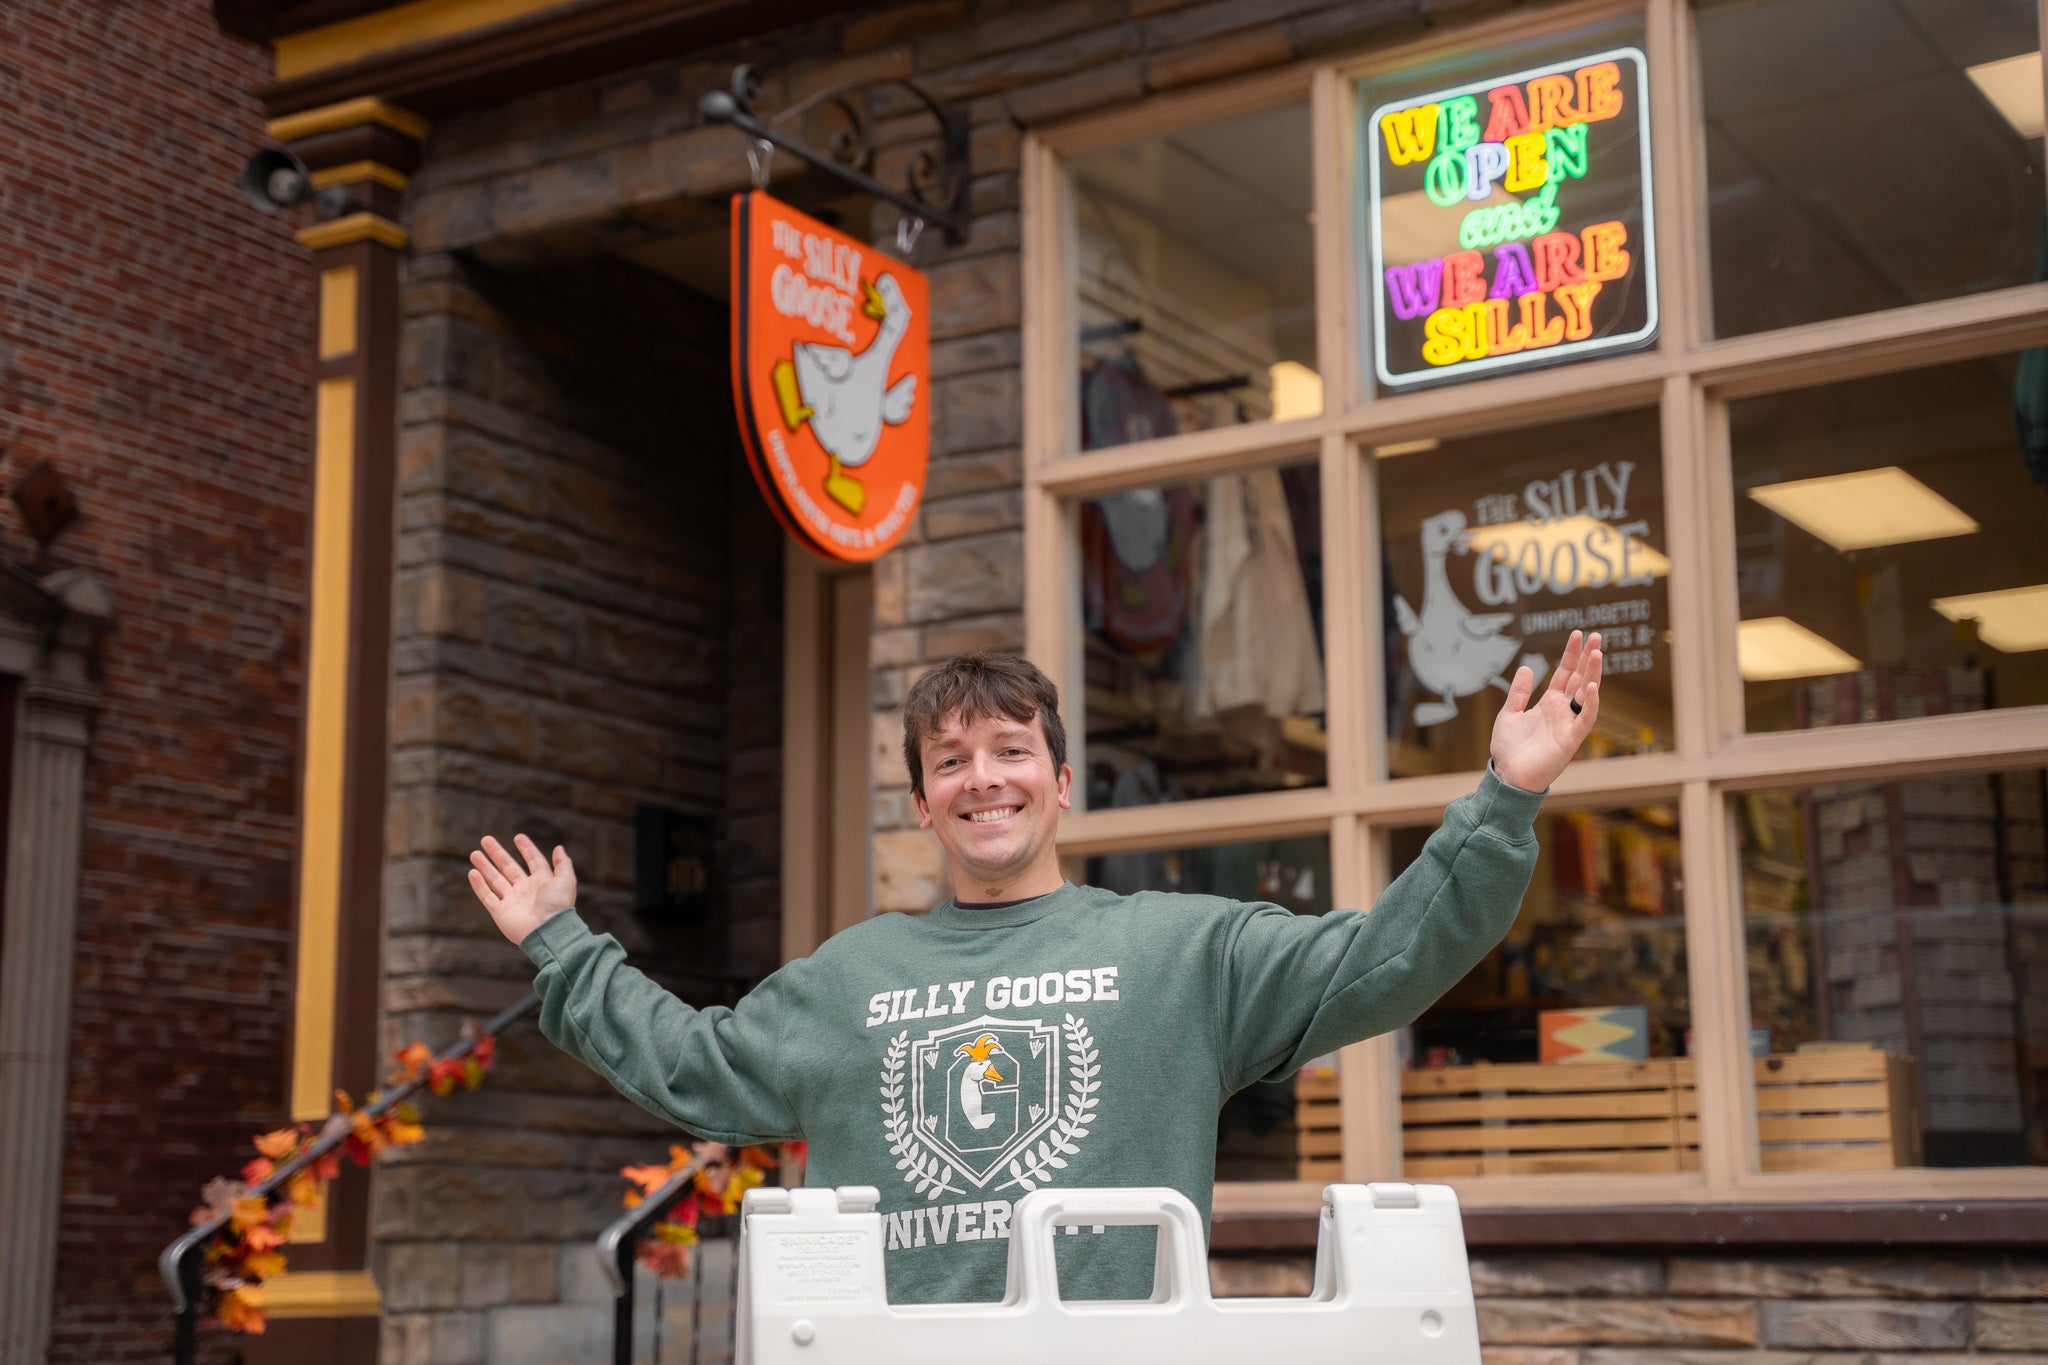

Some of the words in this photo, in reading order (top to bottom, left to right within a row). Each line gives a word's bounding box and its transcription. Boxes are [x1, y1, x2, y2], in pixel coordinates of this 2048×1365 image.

[1380, 94, 1481, 166] WE
[1483, 61, 1625, 143] ARE
[1424, 121, 1589, 208] OPEN
[1458, 183, 1561, 250] and
[803, 233, 863, 296] SILLY
[1384, 250, 1488, 321] WE
[1490, 220, 1631, 300] ARE
[1421, 280, 1603, 366] SILLY
[1474, 493, 1518, 526] THE
[1522, 460, 1636, 528] SILLY
[1474, 519, 1654, 606] GOOSE
[1521, 599, 1652, 635] UNAPOLOGETIC
[1582, 626, 1634, 650] FTS
[866, 980, 976, 1028] SILLY
[985, 966, 1120, 1011] GOOSE
